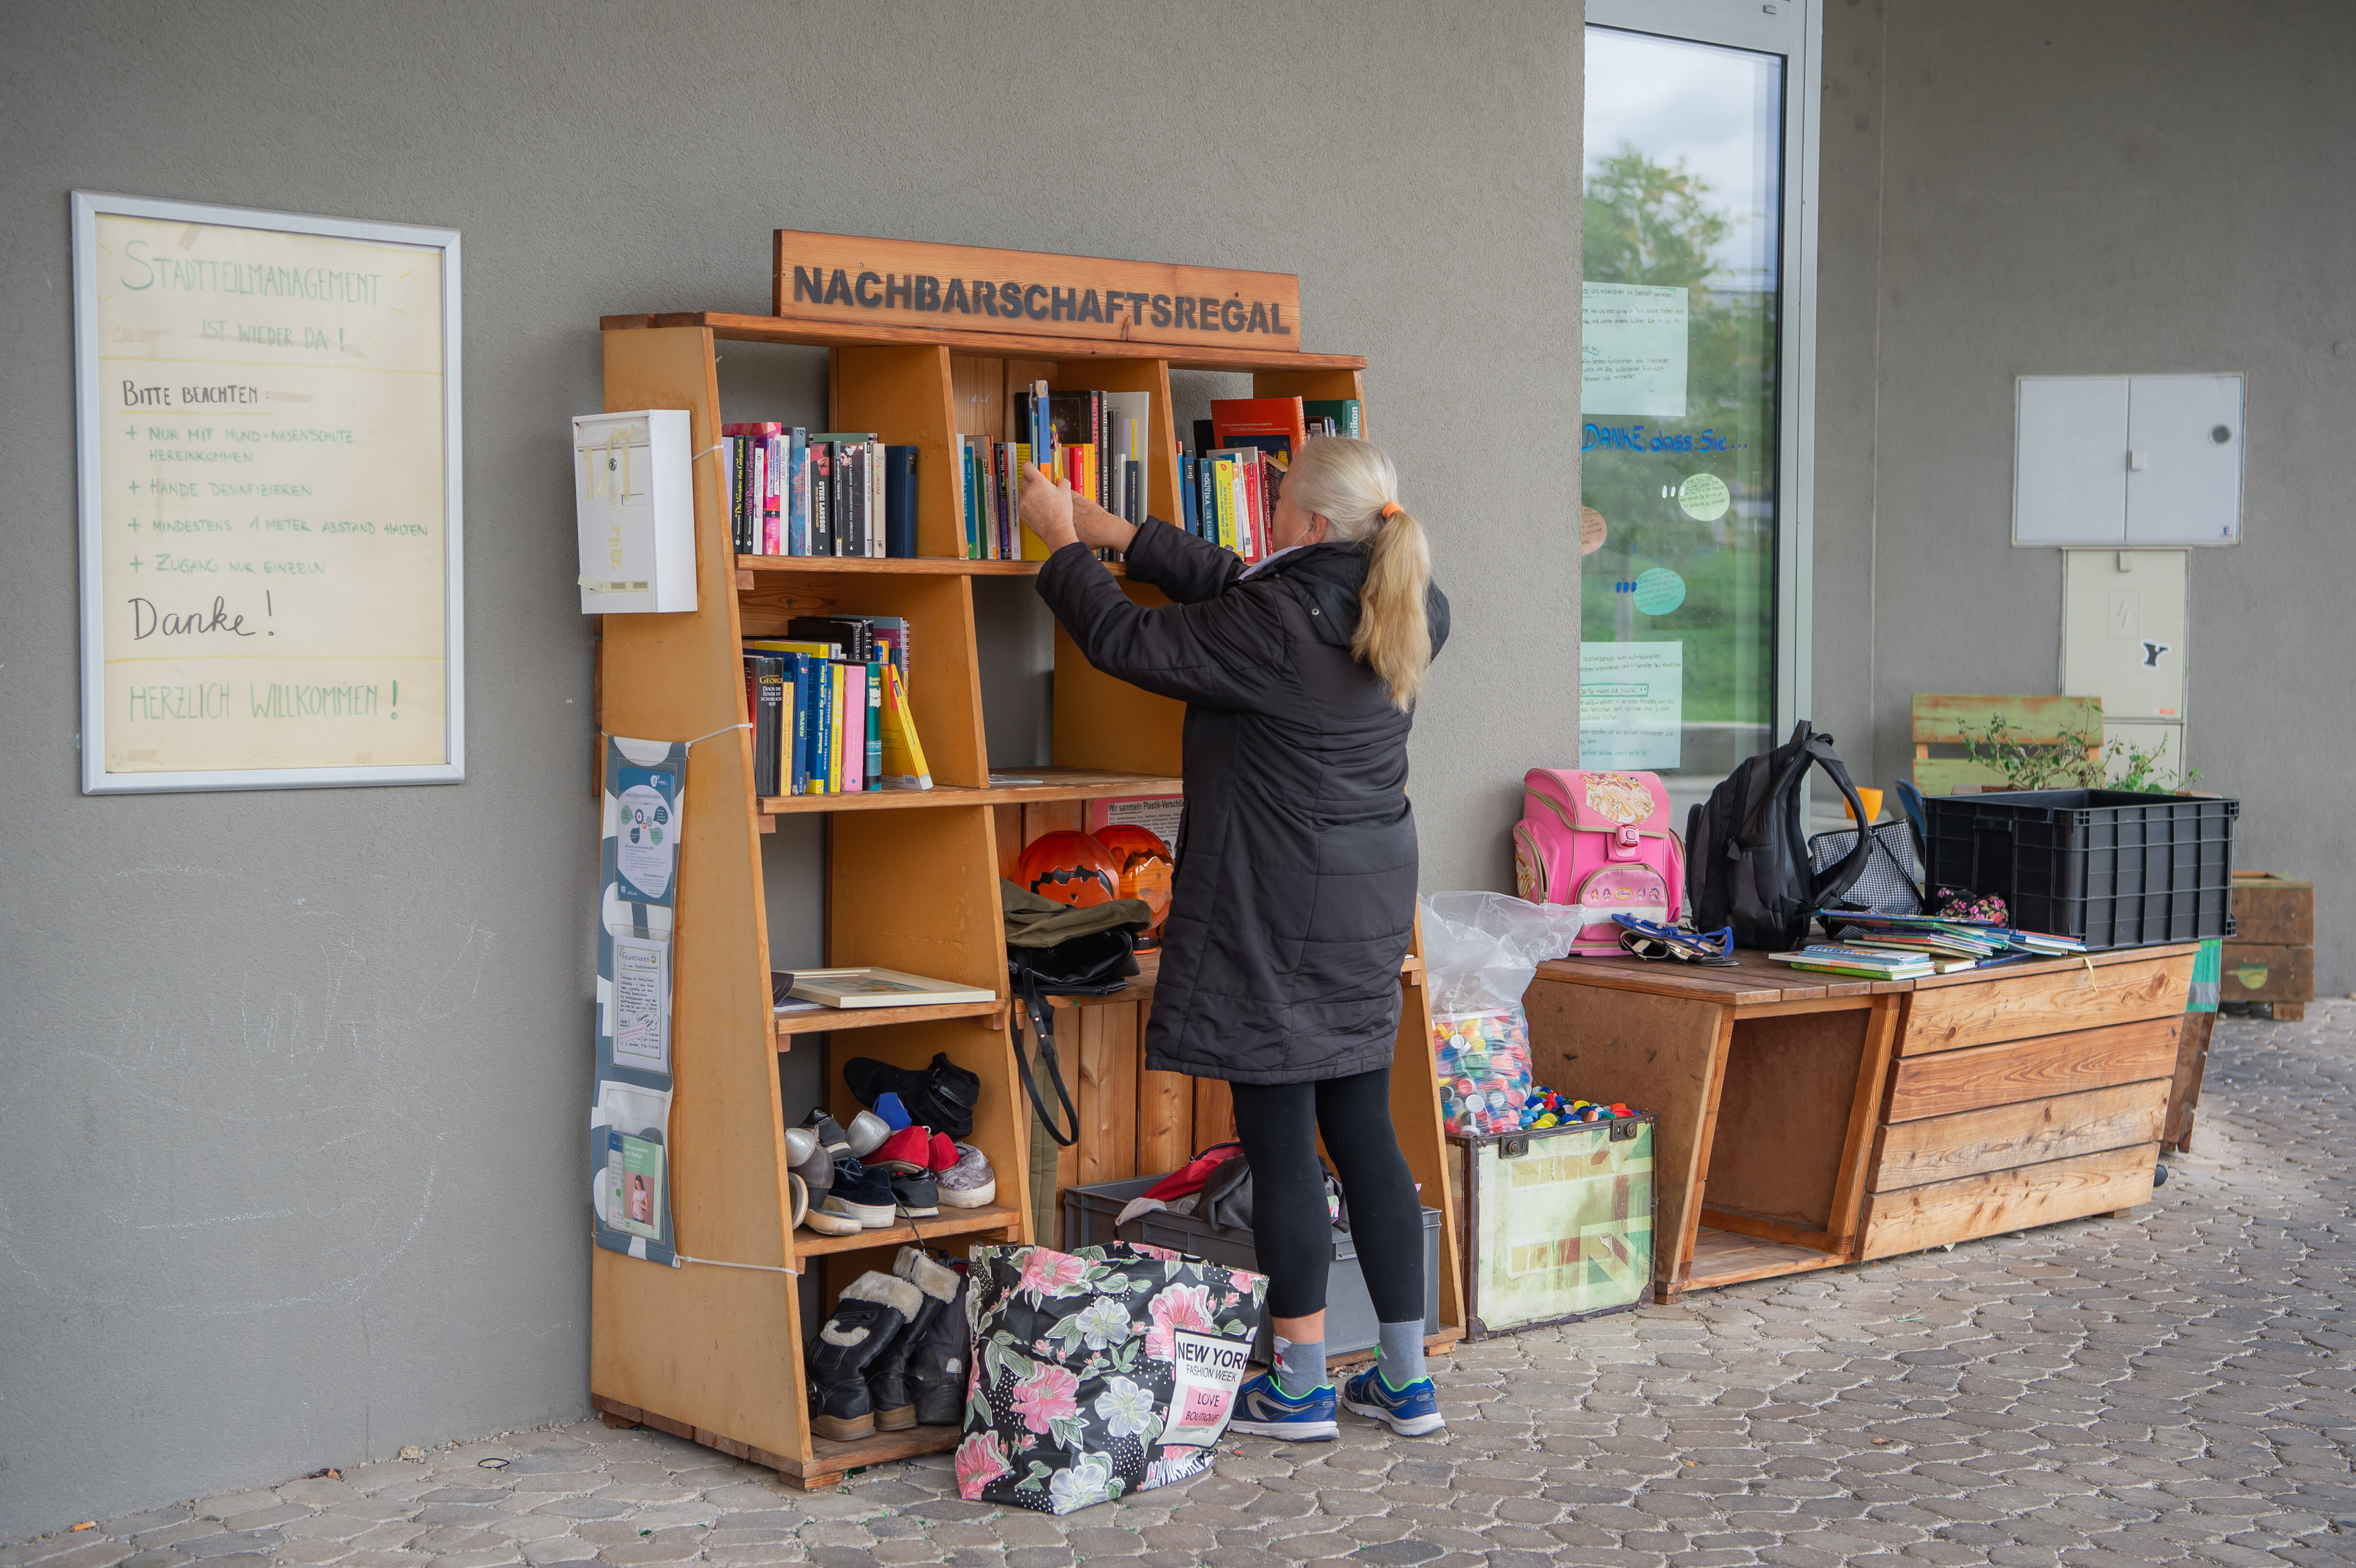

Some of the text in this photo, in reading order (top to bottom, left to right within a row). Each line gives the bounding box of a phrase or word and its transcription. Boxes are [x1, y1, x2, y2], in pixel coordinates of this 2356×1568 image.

[121, 240, 383, 305] STADTTEILMANAGEMENT
[793, 265, 1291, 336] NACHBARSCHAFTSREGAL
[201, 319, 228, 342] IST
[238, 323, 293, 348] WIEDER
[122, 380, 171, 407] BITTE
[149, 426, 180, 442] NUR
[188, 427, 214, 442] MIT
[1350, 406, 1358, 440] exikon
[1651, 427, 1692, 453] dass
[150, 449, 255, 463] HEREINKOMMEN
[150, 478, 313, 497] HÄNDE DESINFIZIEREN
[152, 519, 233, 533] MINDESTENS
[266, 519, 313, 533] METER
[322, 521, 376, 535] ABSTAND
[383, 523, 428, 537] HALTEN
[155, 552, 326, 574] ZUGANG NUR EINZELN
[2142, 642, 2169, 667] Y
[129, 683, 230, 722] HERZLICH
[1108, 799, 1185, 812] Wir sammeln Plastik-Verschlü
[1177, 1342, 1210, 1364] NEW
[1186, 1364, 1239, 1383] FASHION WEEK
[1197, 1391, 1220, 1408] LOVE
[1185, 1410, 1219, 1423] BOUTIQUE
